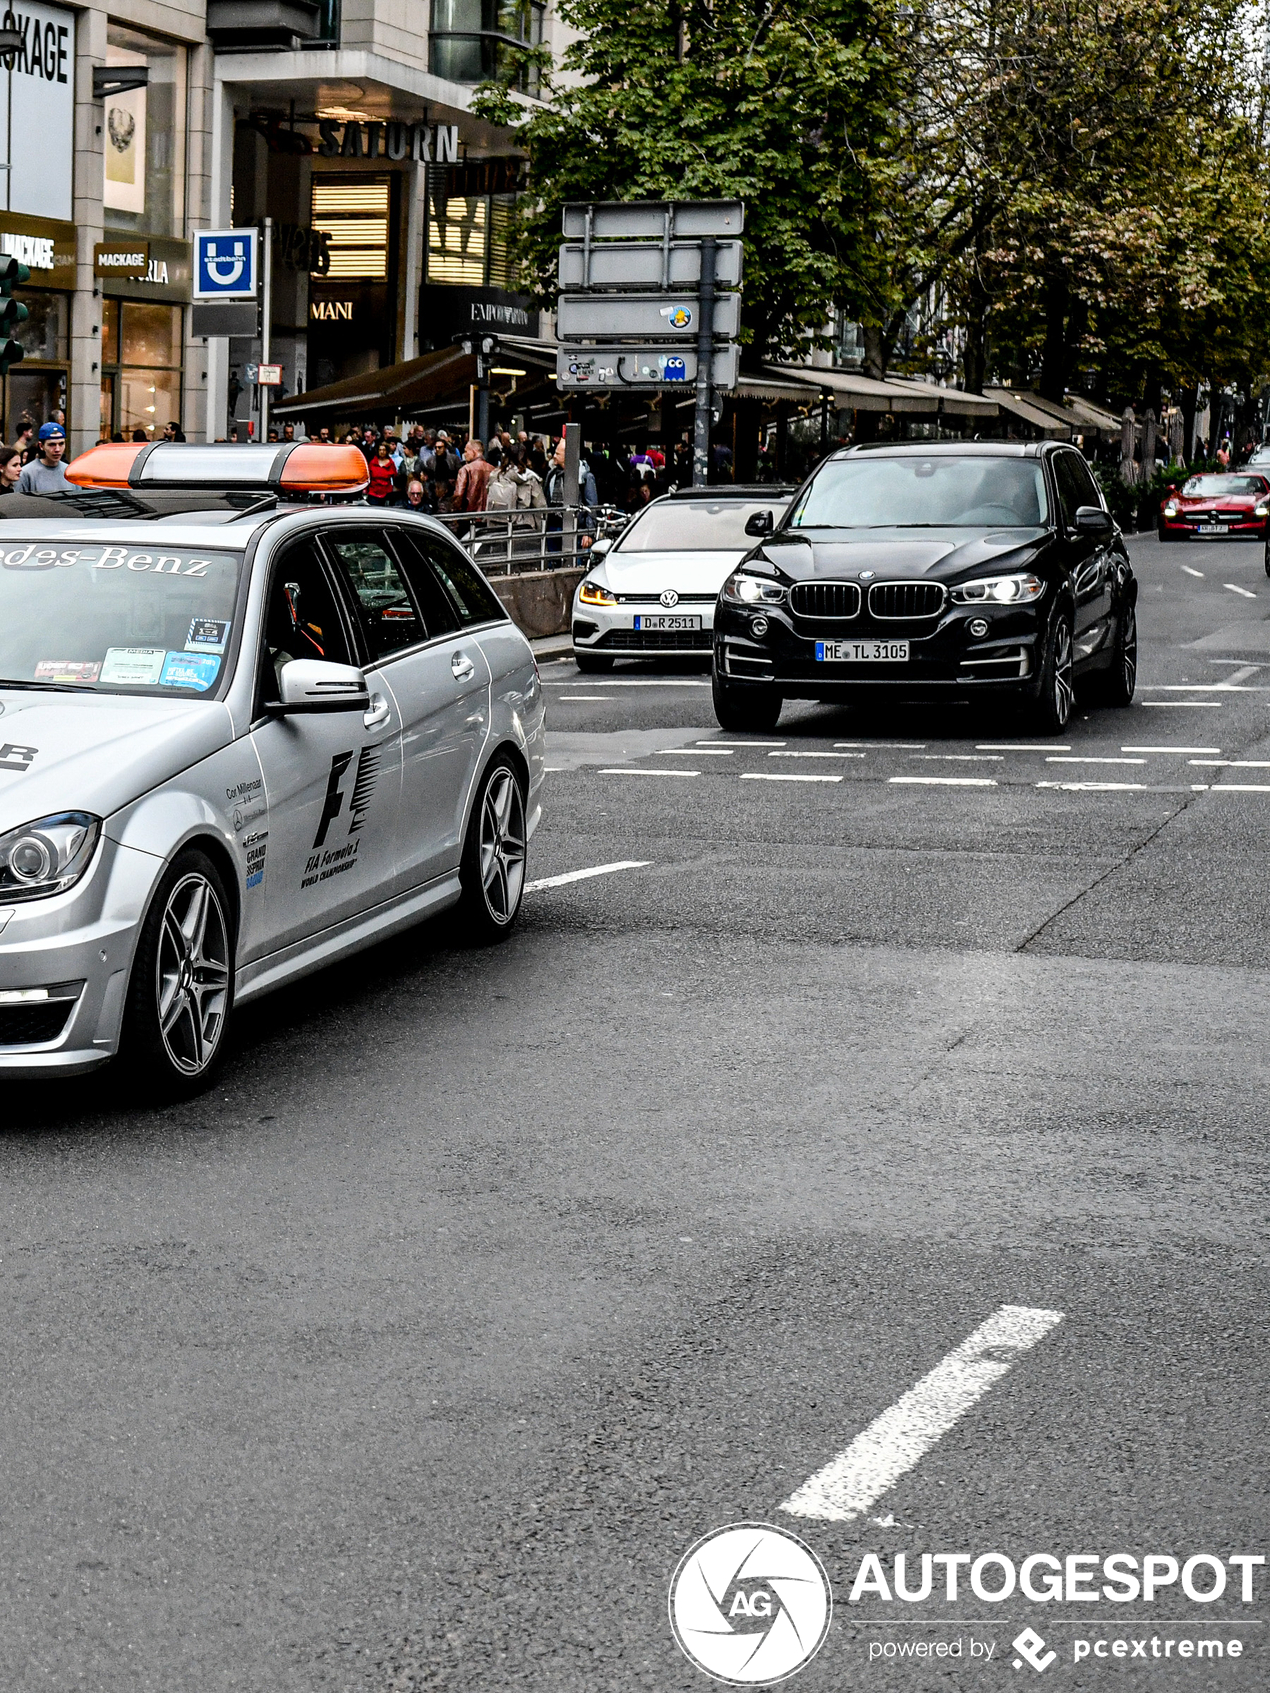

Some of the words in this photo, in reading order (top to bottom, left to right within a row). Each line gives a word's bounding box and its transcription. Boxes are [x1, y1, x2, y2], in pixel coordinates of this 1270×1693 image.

[319, 119, 458, 162] SATURN
[98, 253, 145, 267] MACKAGE
[204, 255, 246, 263] stadtbahn
[644, 617, 651, 628] D
[659, 617, 665, 628] R
[668, 617, 695, 629] 2511
[825, 644, 842, 659] ME
[853, 644, 869, 659] TL
[873, 644, 907, 659] 3105
[226, 787, 237, 799] Cor
[238, 779, 262, 796] Millenaar
[304, 855, 320, 874] FIA
[321, 843, 353, 868] Formula
